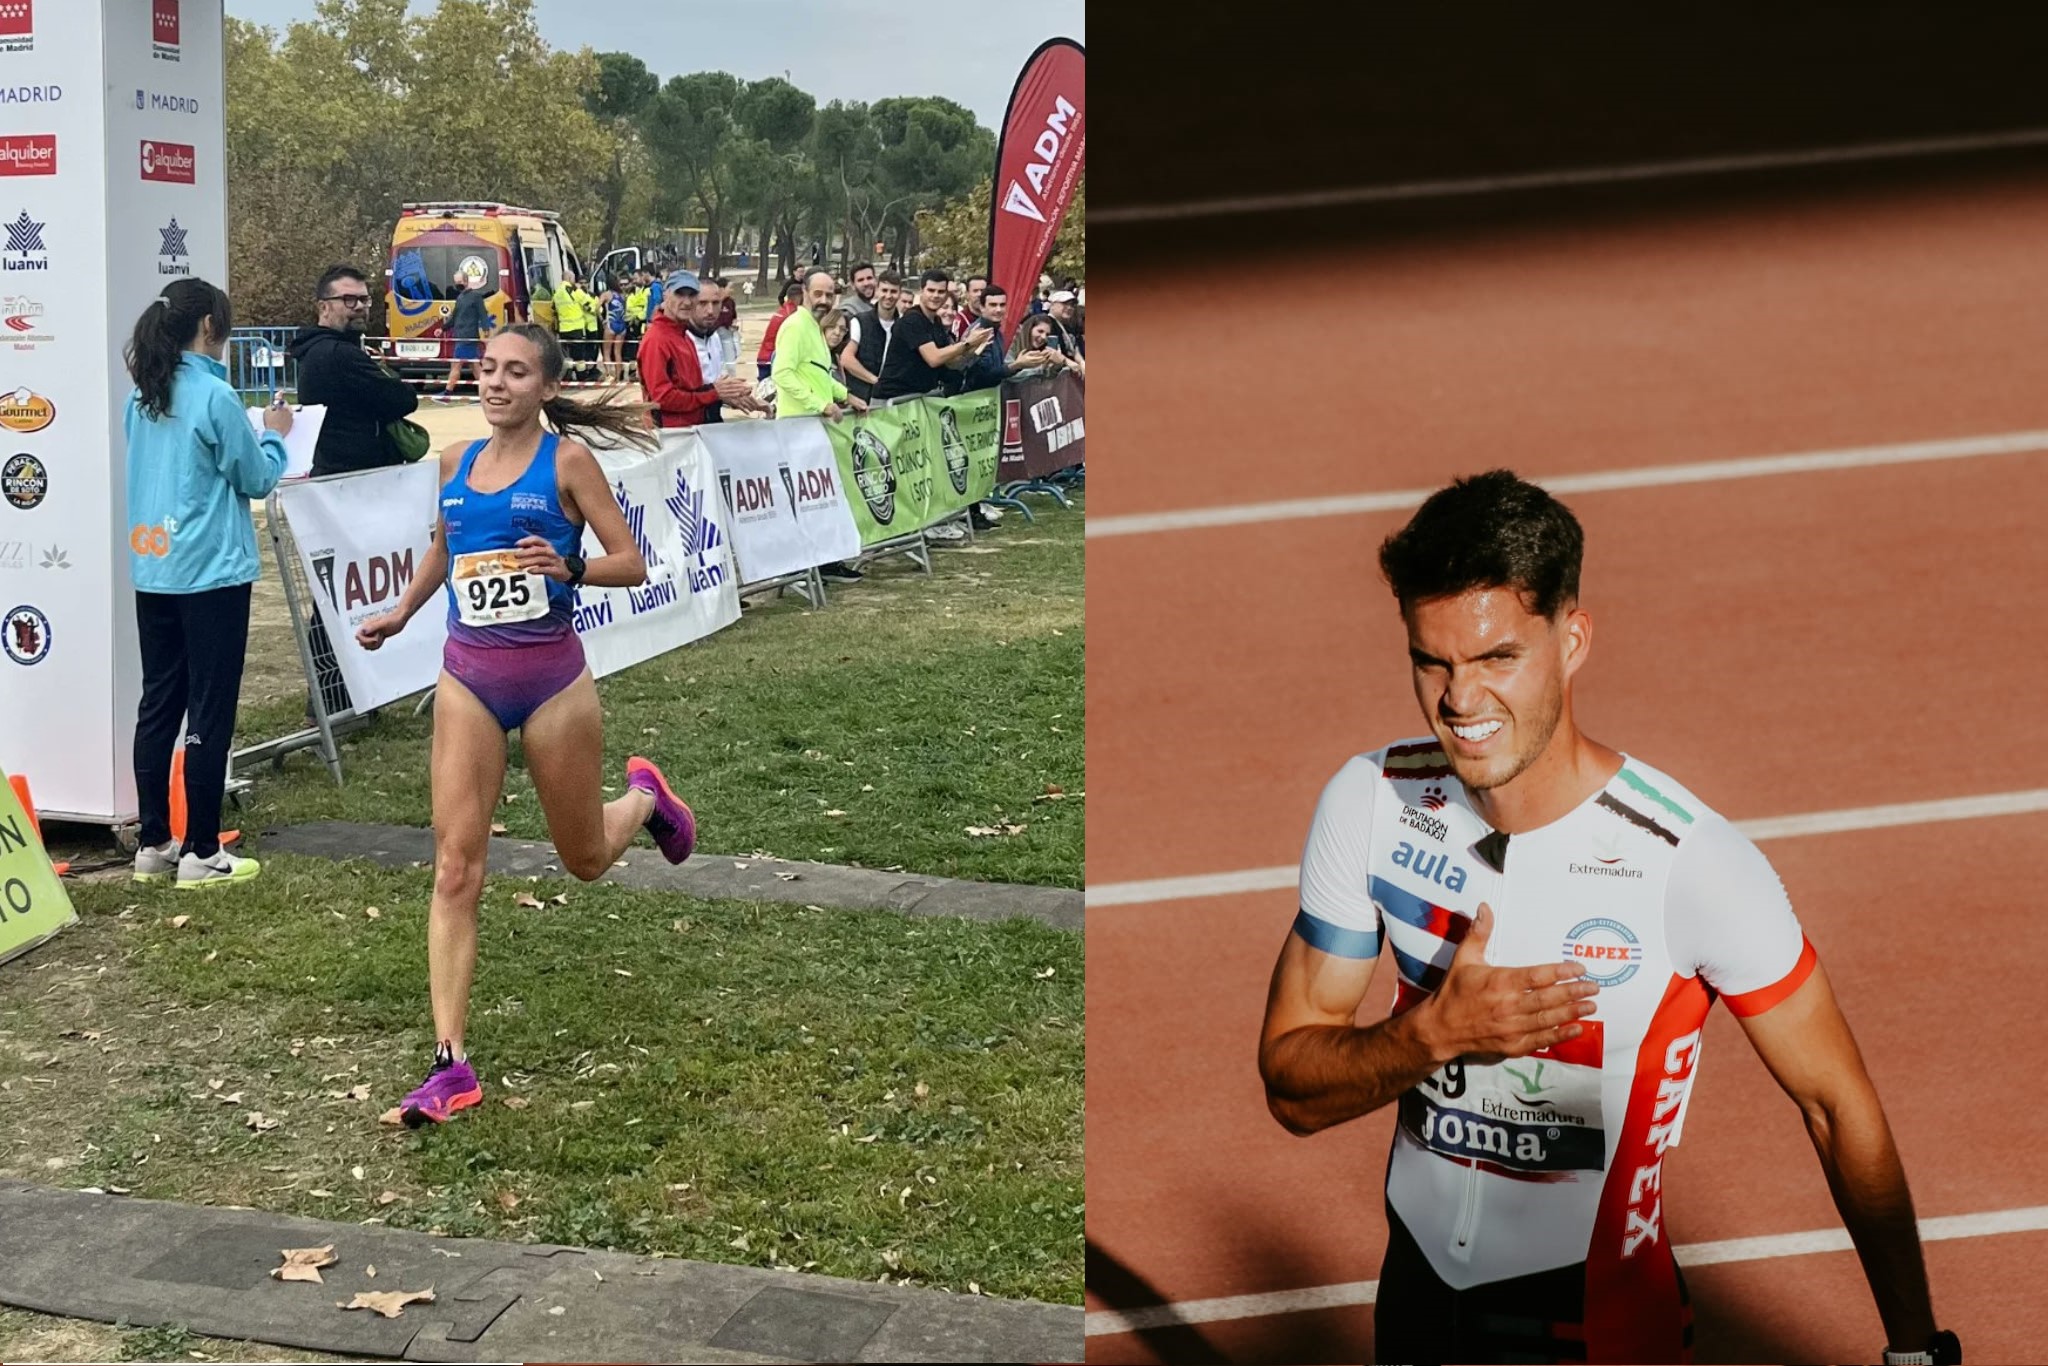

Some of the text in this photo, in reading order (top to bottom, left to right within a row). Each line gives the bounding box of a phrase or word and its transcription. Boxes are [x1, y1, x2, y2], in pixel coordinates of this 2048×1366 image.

[151, 93, 199, 114] MADRID
[0, 140, 53, 168] alquiber
[1025, 95, 1077, 196] ADM
[155, 147, 193, 174] alquiber
[3, 256, 48, 271] luanvi
[157, 261, 190, 276] luanvi
[736, 476, 774, 513] ADM
[798, 467, 836, 503] ADM
[344, 547, 414, 611] ADM
[468, 573, 531, 611] 925
[627, 573, 678, 616] luanvi
[574, 592, 613, 634] anvi
[1402, 805, 1449, 834] DIPUTACIÓN
[1409, 818, 1447, 843] BADAJOZ
[1391, 840, 1468, 894] aula
[1569, 862, 1643, 879] Extremadura
[1573, 943, 1631, 961] CAPEX
[1482, 1097, 1585, 1126] Extremadura
[1620, 1029, 1701, 1260] CAPEX
